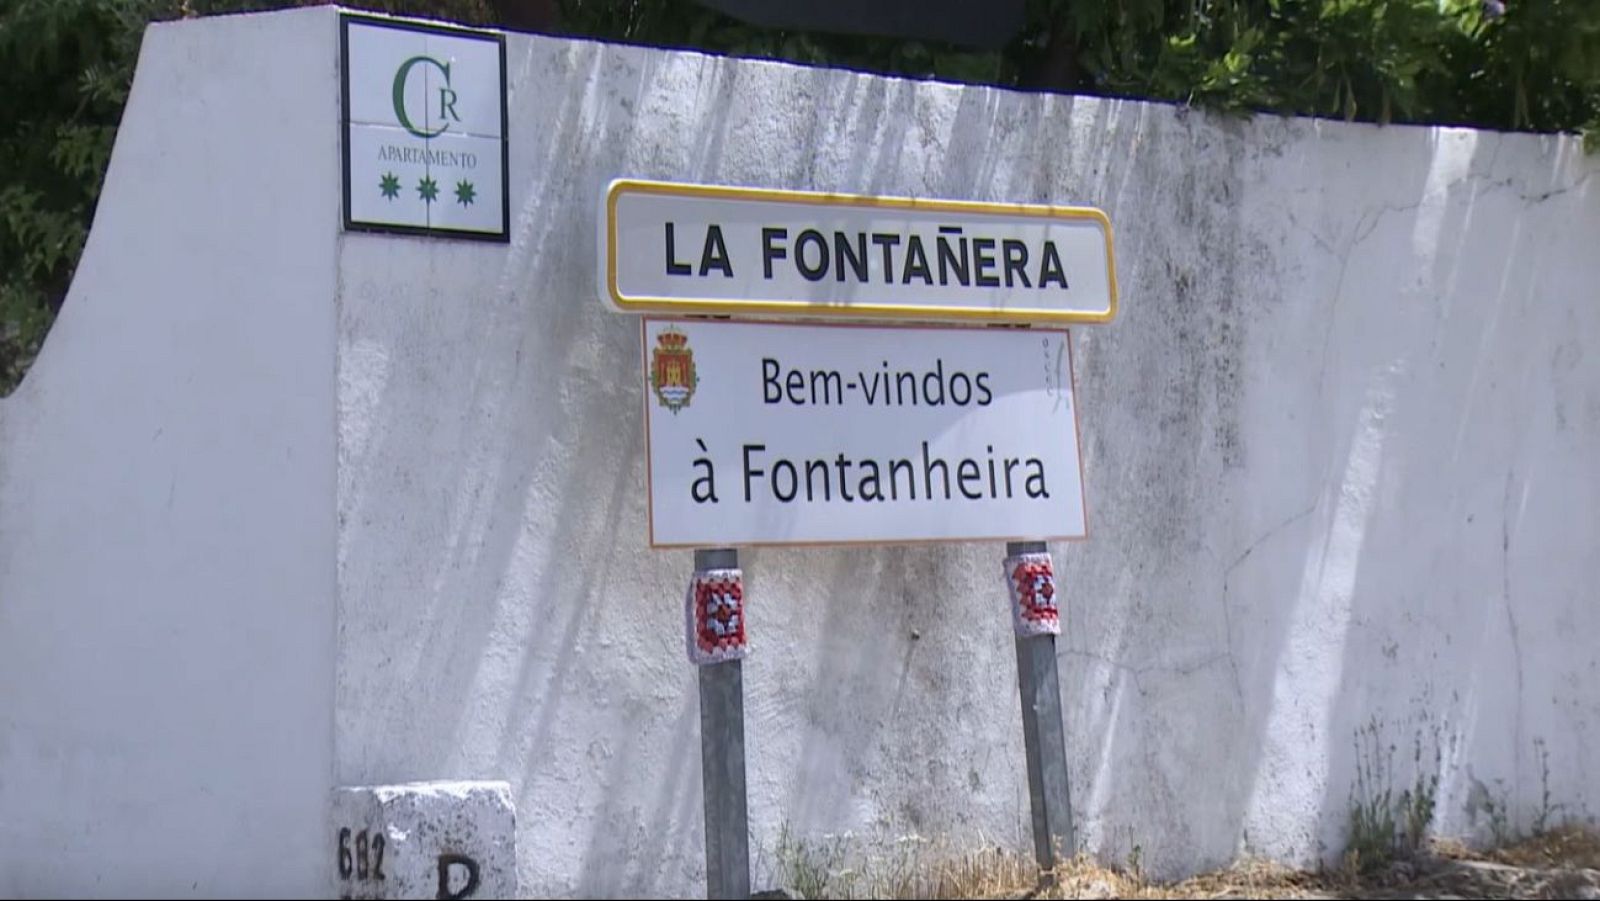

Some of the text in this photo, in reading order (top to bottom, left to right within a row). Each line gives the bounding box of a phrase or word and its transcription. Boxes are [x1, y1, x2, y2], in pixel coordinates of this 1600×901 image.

[378, 146, 477, 168] APARTAMENTO
[665, 222, 1069, 289] LA FONTAÑERA
[761, 358, 993, 406] Bem-vindos
[691, 438, 1050, 503] à Fontanheira
